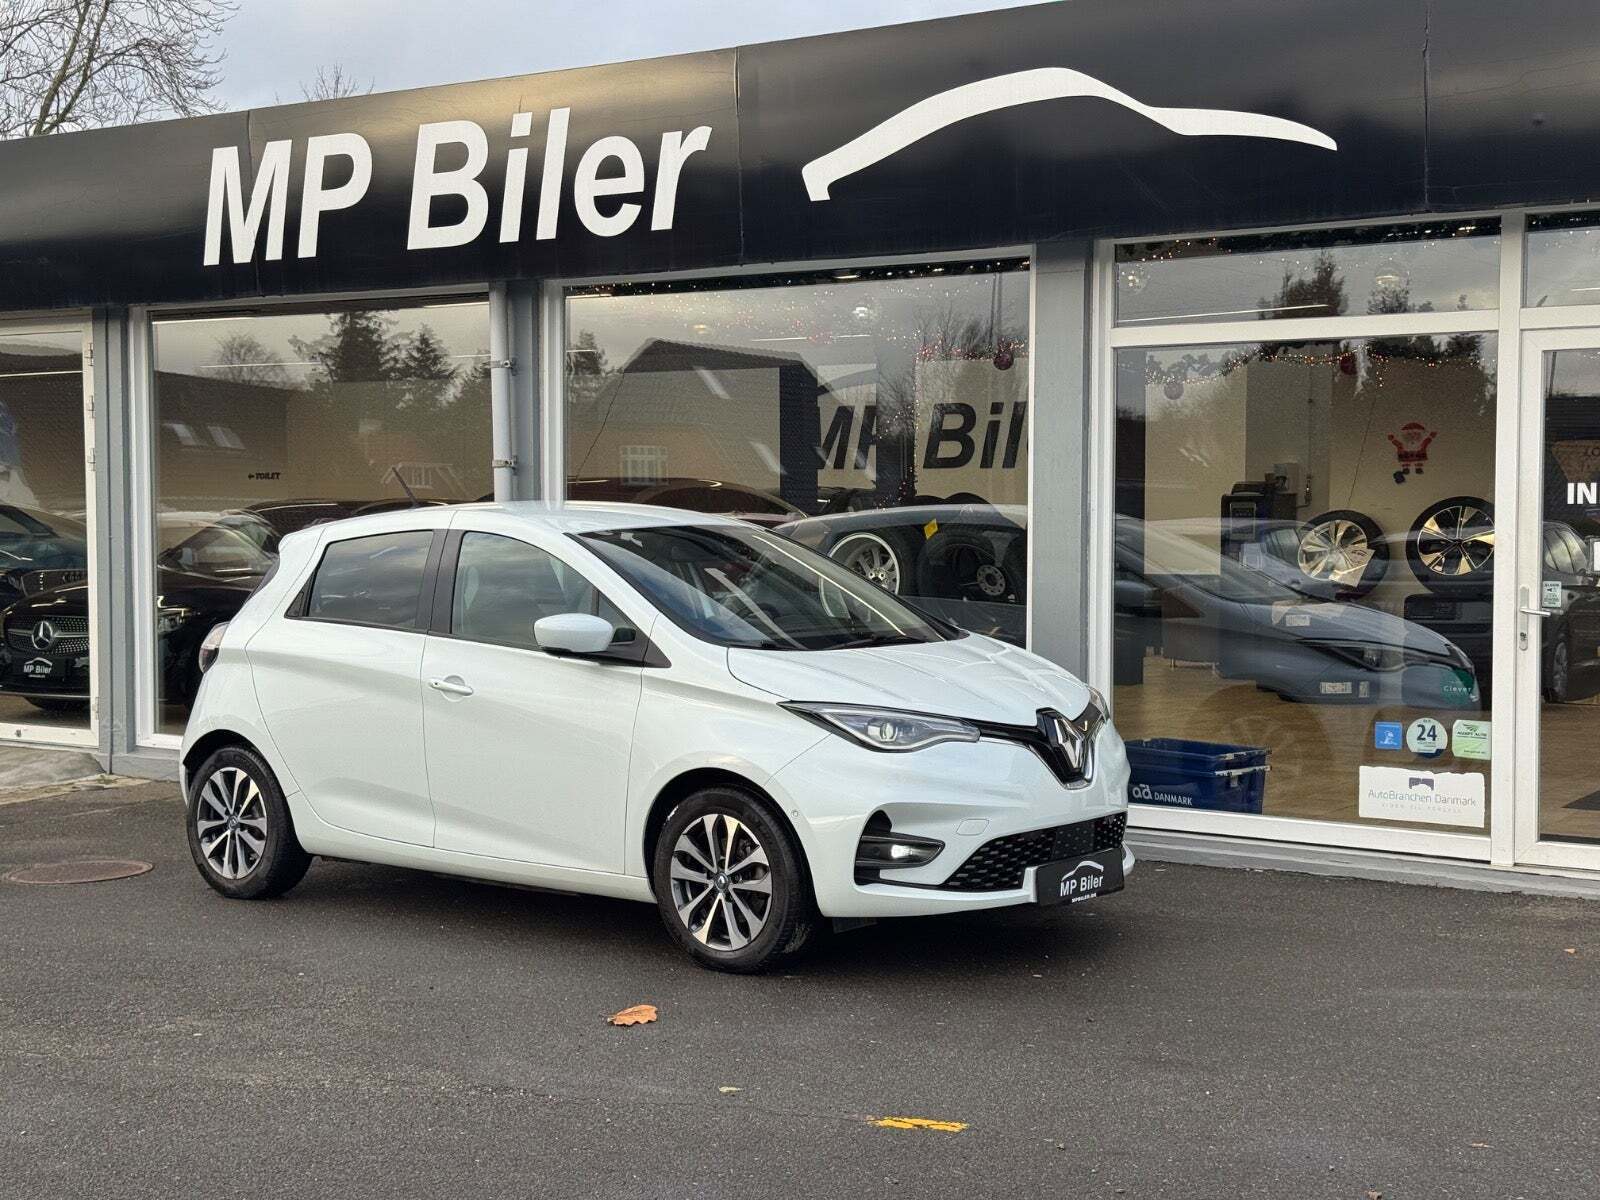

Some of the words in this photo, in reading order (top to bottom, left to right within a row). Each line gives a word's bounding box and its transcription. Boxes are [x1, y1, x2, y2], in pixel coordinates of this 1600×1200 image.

[203, 133, 373, 266] MP
[407, 107, 712, 250] Biler
[254, 472, 280, 480] TOILET
[1567, 482, 1600, 505] IN
[24, 665, 34, 673] MP
[36, 665, 52, 674] Biler
[1416, 723, 1438, 742] 24
[1154, 792, 1193, 806] DANMARK
[1368, 789, 1432, 804] AutoBranchen
[1435, 794, 1476, 807] Danmark
[1060, 880, 1077, 896] MP
[1080, 875, 1103, 892] Biler
